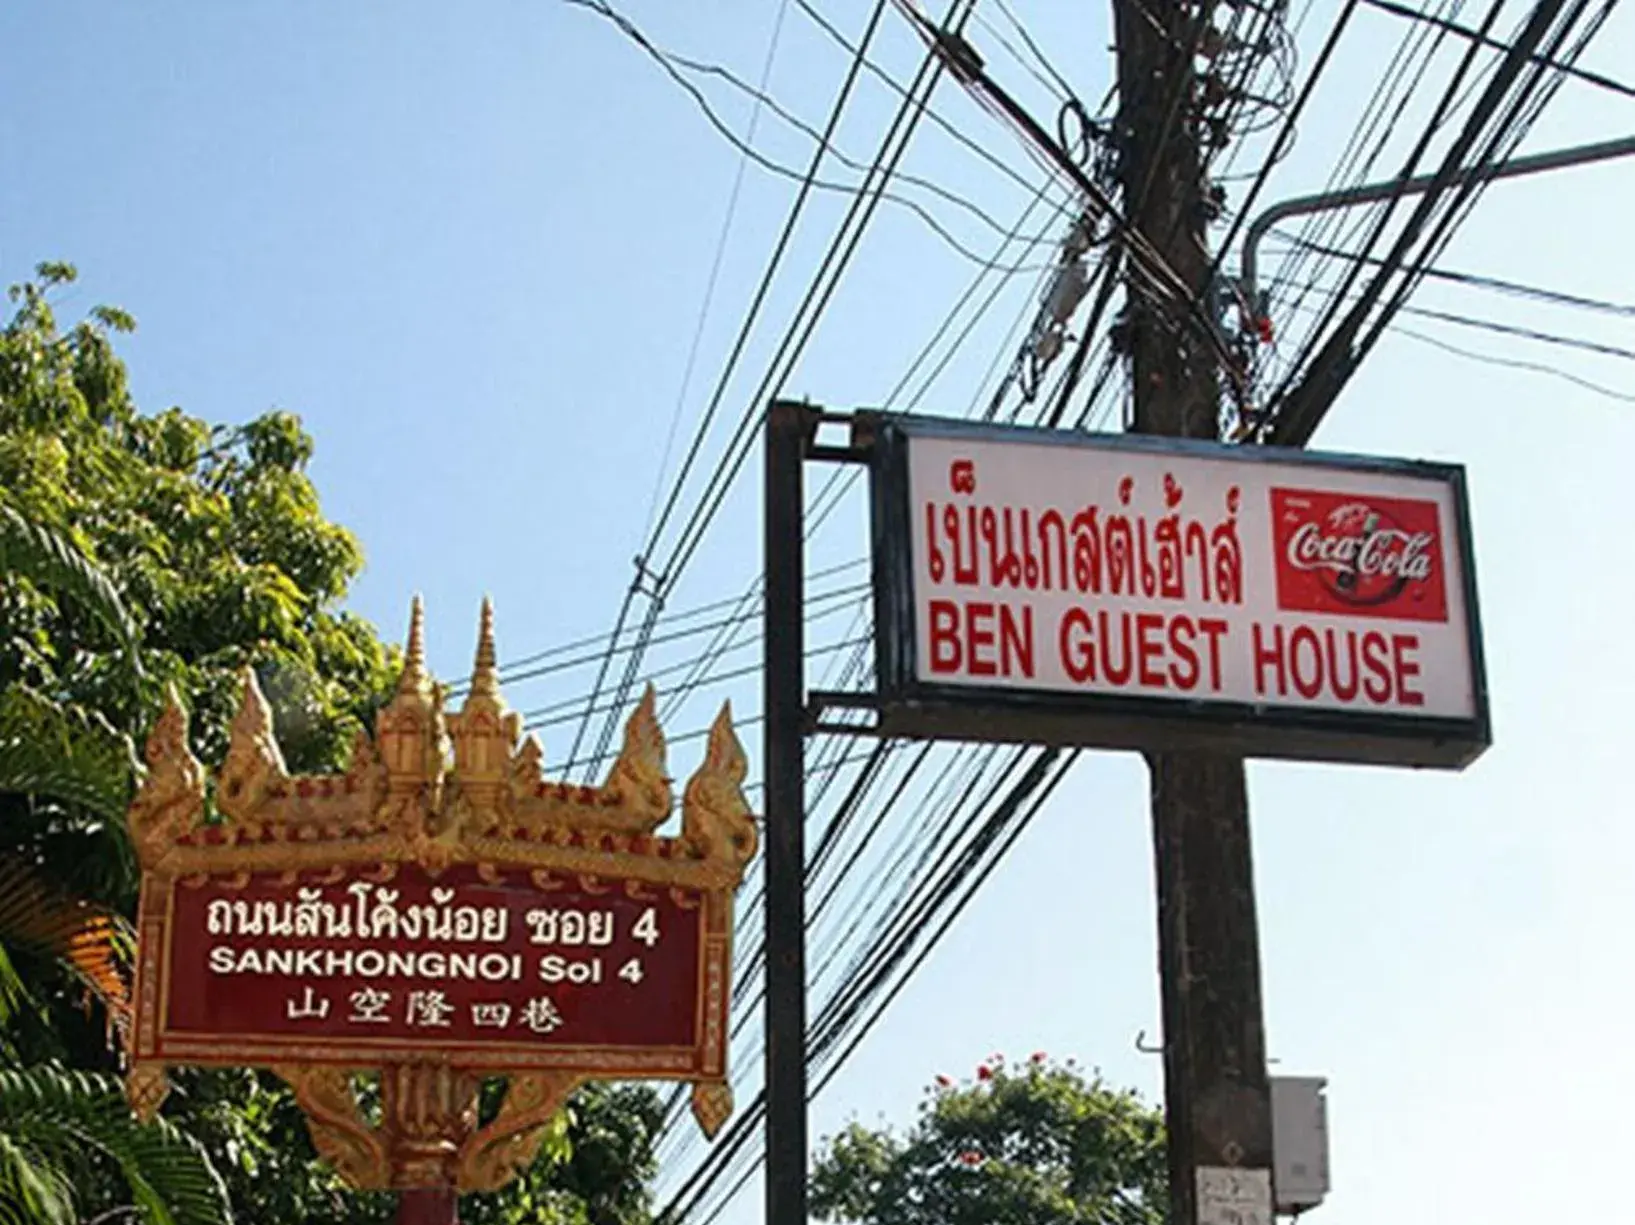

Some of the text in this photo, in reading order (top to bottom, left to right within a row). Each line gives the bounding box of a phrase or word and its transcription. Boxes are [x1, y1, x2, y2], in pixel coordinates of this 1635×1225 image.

[929, 599, 1425, 704] BEN GUEST HOUSE
[526, 909, 612, 944] ซอย
[633, 908, 658, 945] 4
[209, 947, 521, 979] SANKHONGNOI
[618, 958, 643, 983] 4
